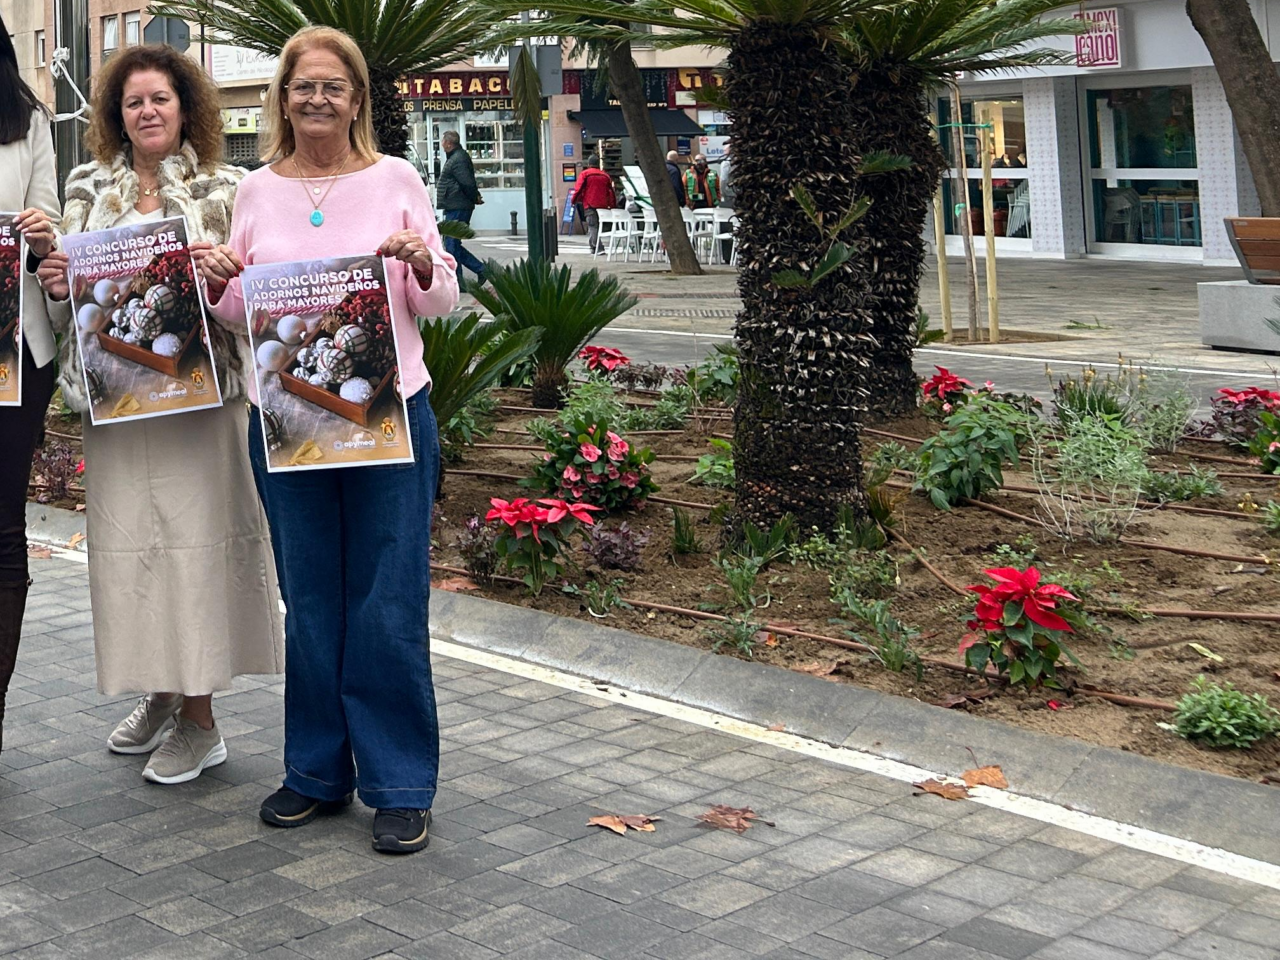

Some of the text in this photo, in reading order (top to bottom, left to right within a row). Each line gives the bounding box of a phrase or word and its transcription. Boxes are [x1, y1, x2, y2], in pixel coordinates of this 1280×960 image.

[422, 100, 463, 111] PRENSA
[71, 231, 177, 258] IV CONCURSO DE
[73, 242, 183, 267] ADORNOS NAVIDEÑOS
[74, 259, 150, 276] PARA MAYORES
[251, 268, 373, 290] IV CONCURSO DE
[253, 280, 380, 301] ADORNOS NAVIDEÑOS
[254, 295, 342, 311] PARA MAYORES
